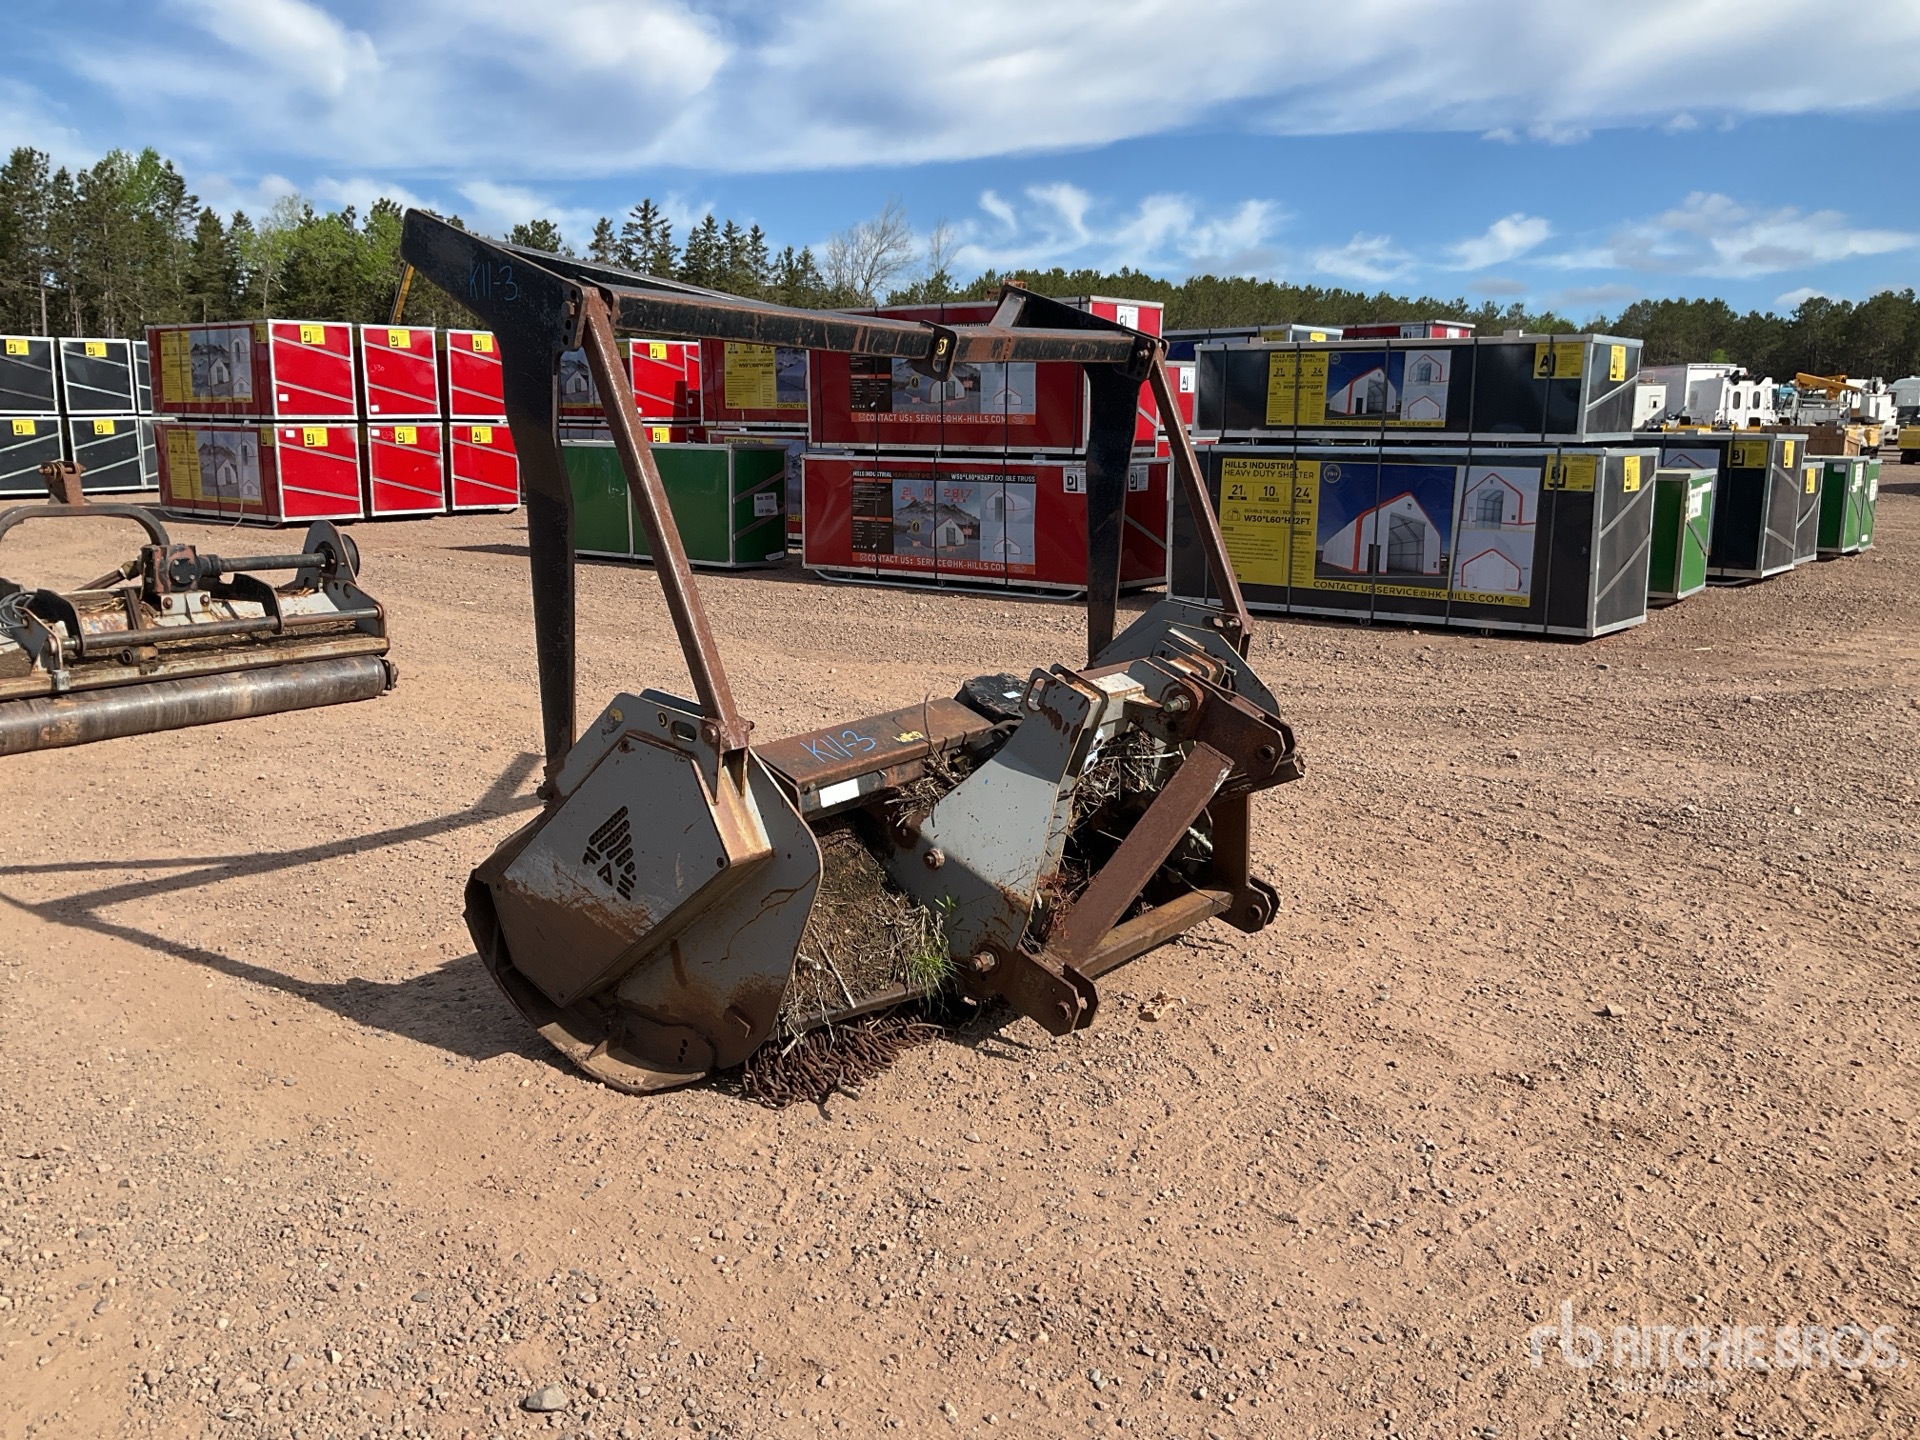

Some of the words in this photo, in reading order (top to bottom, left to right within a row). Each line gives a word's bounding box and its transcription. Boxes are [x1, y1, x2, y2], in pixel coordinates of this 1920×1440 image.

[469, 258, 518, 300] K11-3
[1540, 355, 1549, 368] A
[1182, 376, 1187, 386] A
[866, 414, 896, 422] CONTACT
[900, 414, 912, 422] US:
[1733, 450, 1740, 459] B
[1224, 460, 1248, 469] HILLS
[1250, 461, 1300, 470] INDUSTRIAL
[1017, 475, 1036, 483] TRUSS
[1224, 469, 1250, 477] HEAVY
[1252, 470, 1276, 478] DUTY
[1278, 471, 1314, 480] SHELTER
[1067, 476, 1074, 486] D
[1232, 484, 1243, 496] 21
[1264, 486, 1275, 496] 10
[868, 555, 898, 564] CONTACT
[900, 557, 913, 565] US:
[916, 558, 1006, 572] SERVCE@HK-HILLS.COM
[1313, 580, 1358, 592] CONTACT
